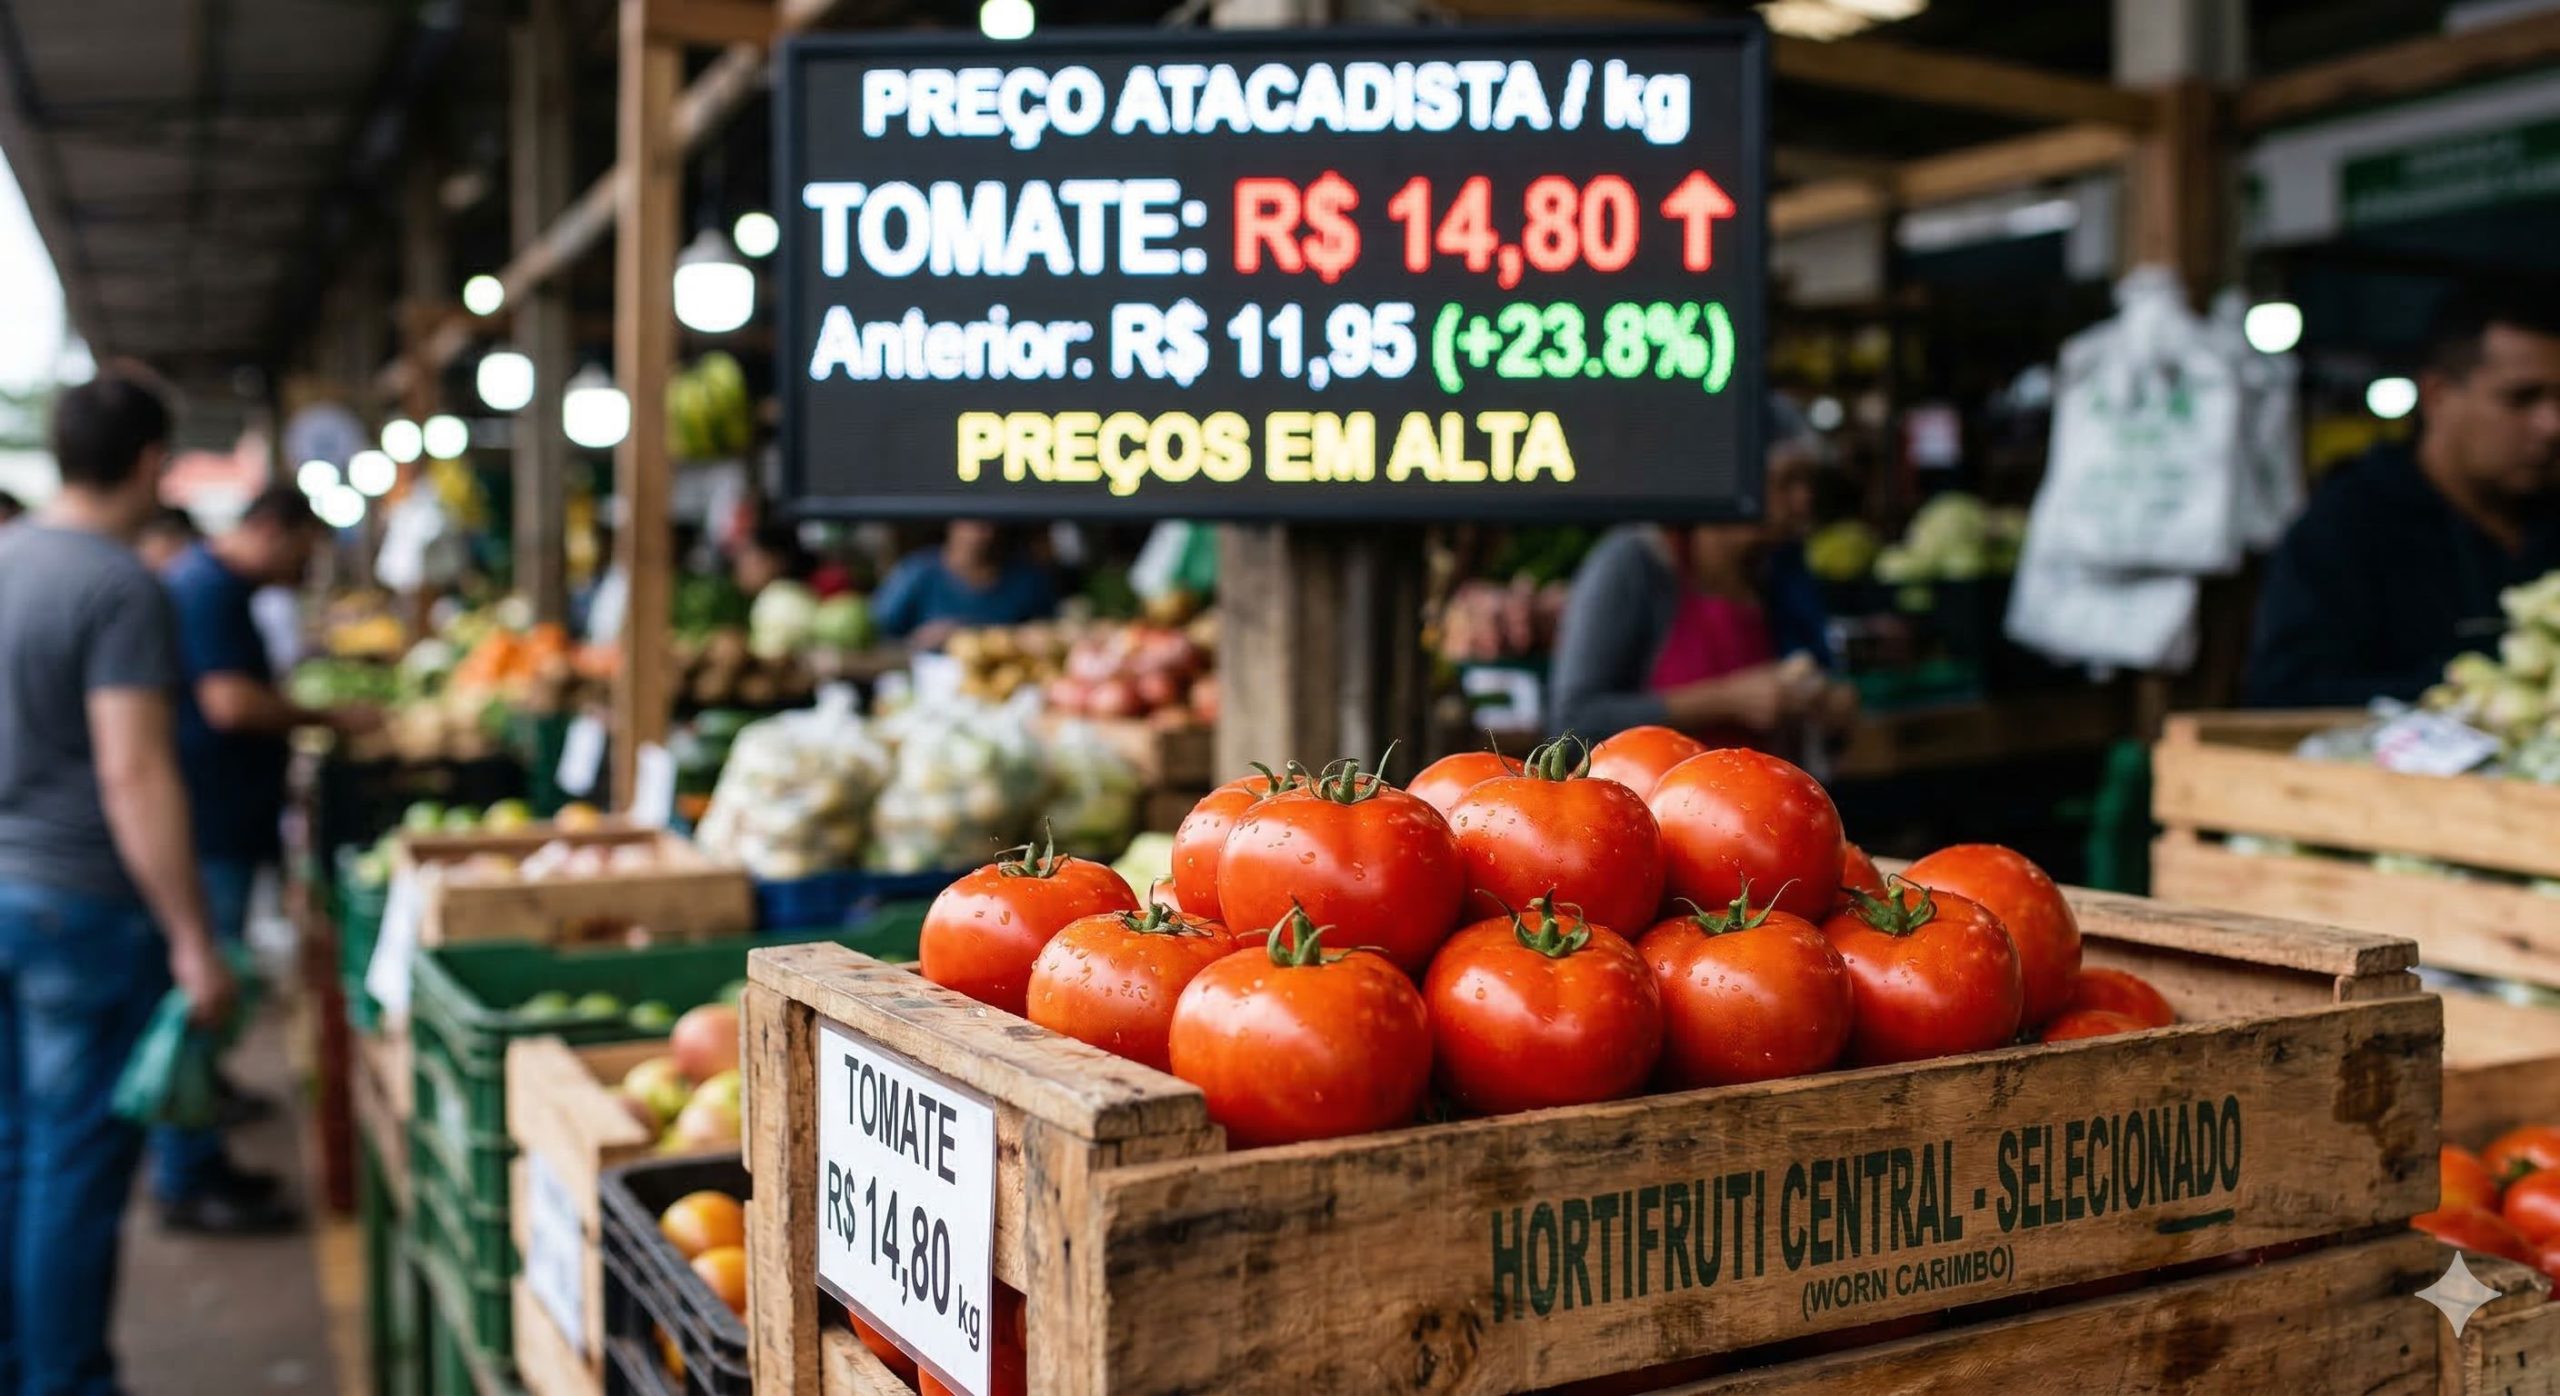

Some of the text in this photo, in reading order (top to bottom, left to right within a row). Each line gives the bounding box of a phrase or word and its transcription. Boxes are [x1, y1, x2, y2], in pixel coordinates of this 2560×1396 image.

[862, 59, 1691, 150] PREÇO ATACADISTA / kg
[804, 170, 1640, 290] TOMATE: R$ 14,80
[810, 299, 1735, 393] Anterior: R$ 11,95 (+23.8%)
[957, 411, 1575, 496] PREÇOS EM ALTA
[844, 1053, 957, 1186] TOMATE
[827, 1160, 981, 1353] R$ 14,80 kg
[1491, 1095, 2243, 1323] HORTIFRUTI CENTRAL - SELECIONADO
[1801, 1244, 2015, 1323] (WORN CARIMBO)
